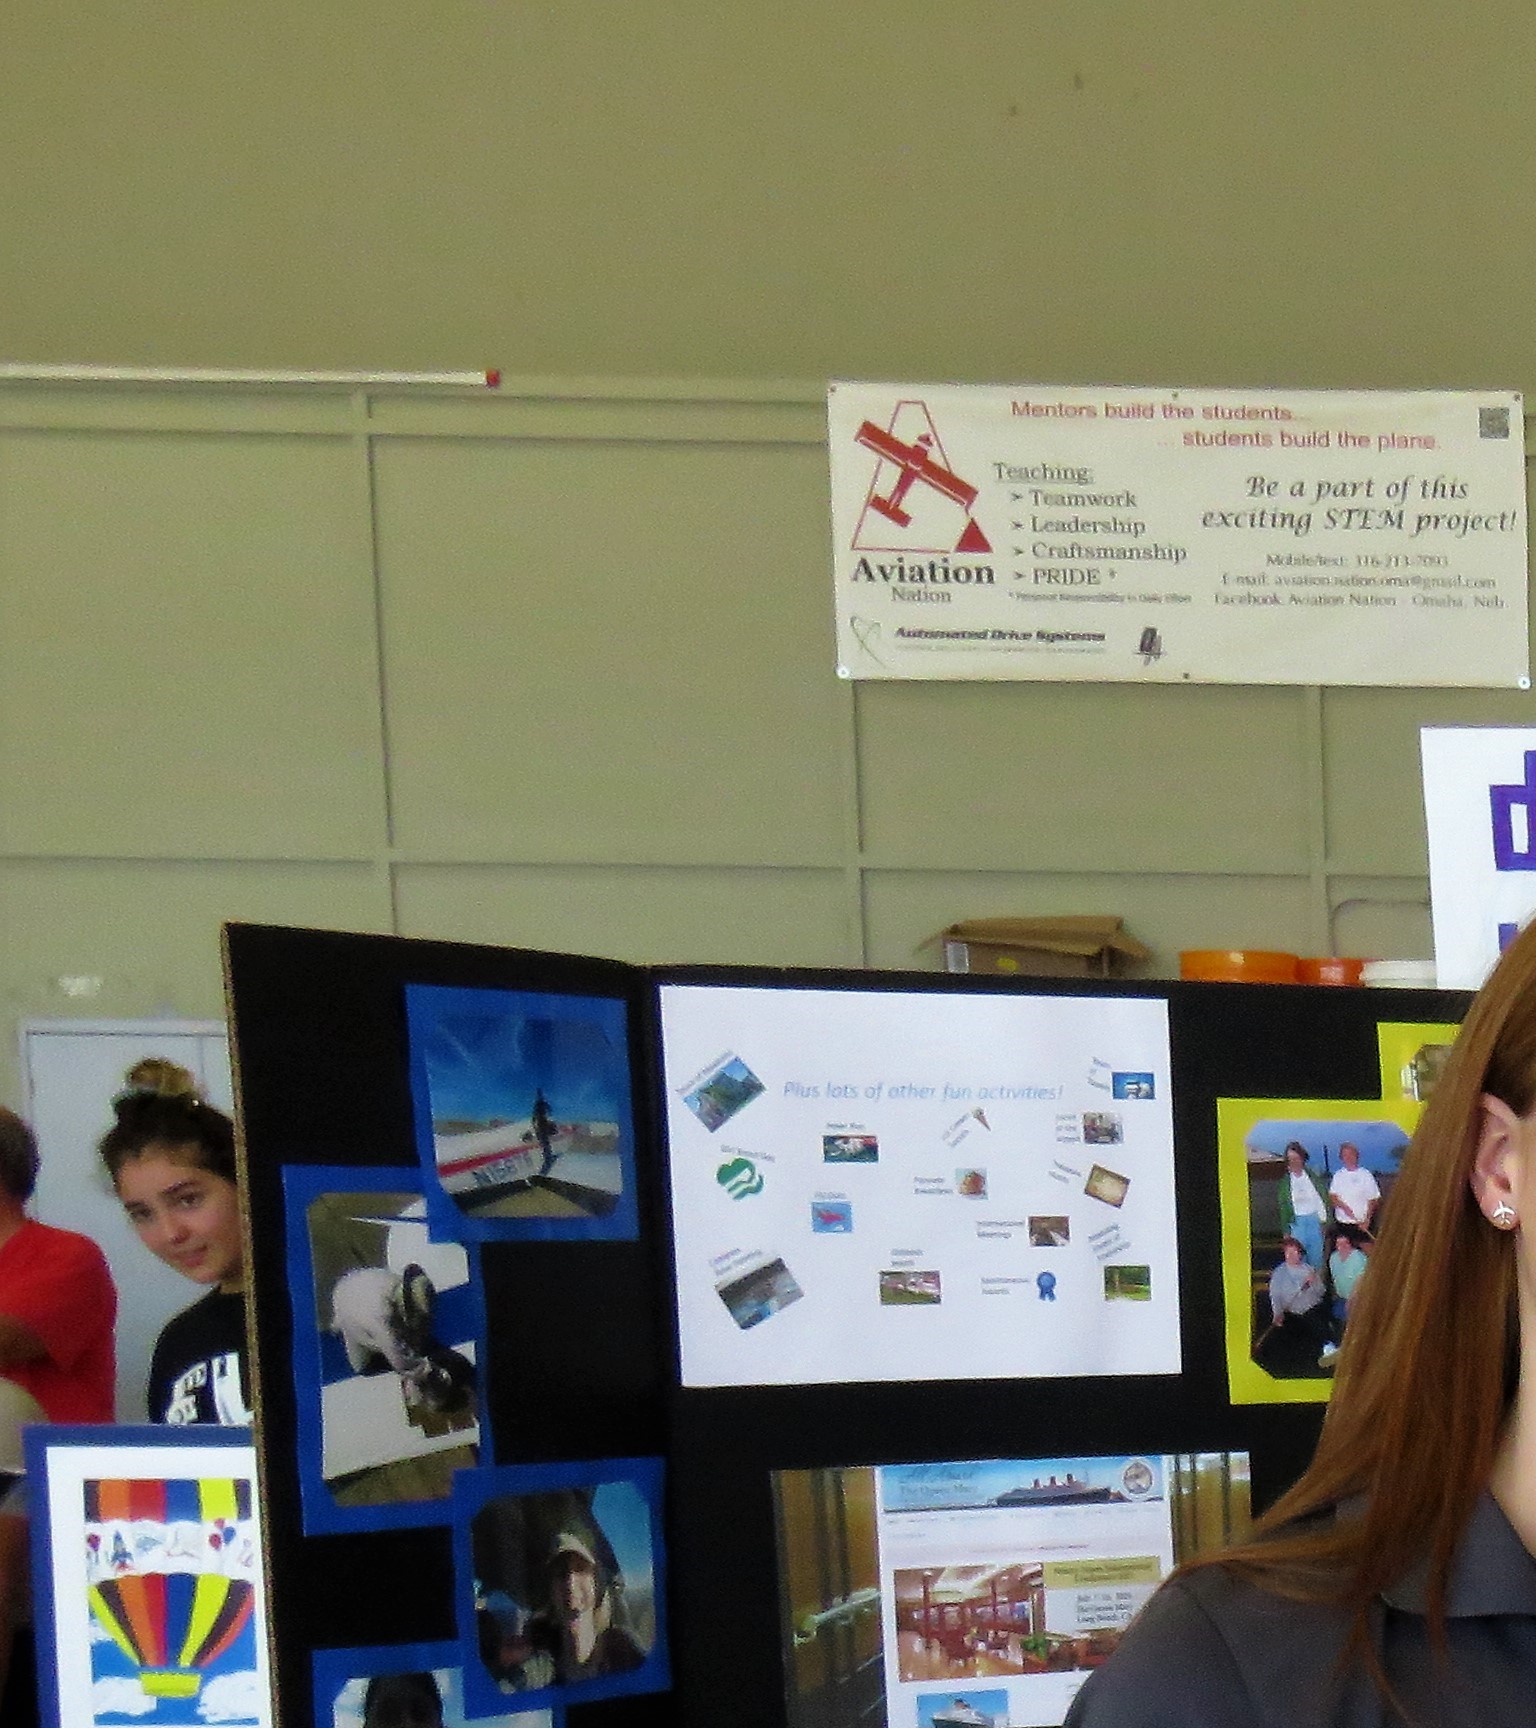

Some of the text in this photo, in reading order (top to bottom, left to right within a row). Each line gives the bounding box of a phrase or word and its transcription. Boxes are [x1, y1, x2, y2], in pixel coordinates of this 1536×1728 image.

[1012, 401, 1098, 419] Mentors
[1104, 401, 1155, 421] build
[1162, 402, 1195, 421] the
[1182, 430, 1273, 448] students
[1280, 431, 1331, 450] build
[1338, 431, 1371, 449] the
[1029, 490, 1138, 508] Teamwork
[1246, 475, 1469, 505] Be a part of this
[1031, 515, 1146, 538] Leadership
[1202, 507, 1518, 539] exciting STEM project!
[1031, 543, 1188, 565] Craftsmanship
[852, 557, 996, 586] Aviation
[1031, 568, 1101, 586] PRIDE
[890, 585, 952, 603] Nation
[783, 1081, 1064, 1103] Plus lots of other fun activities!
